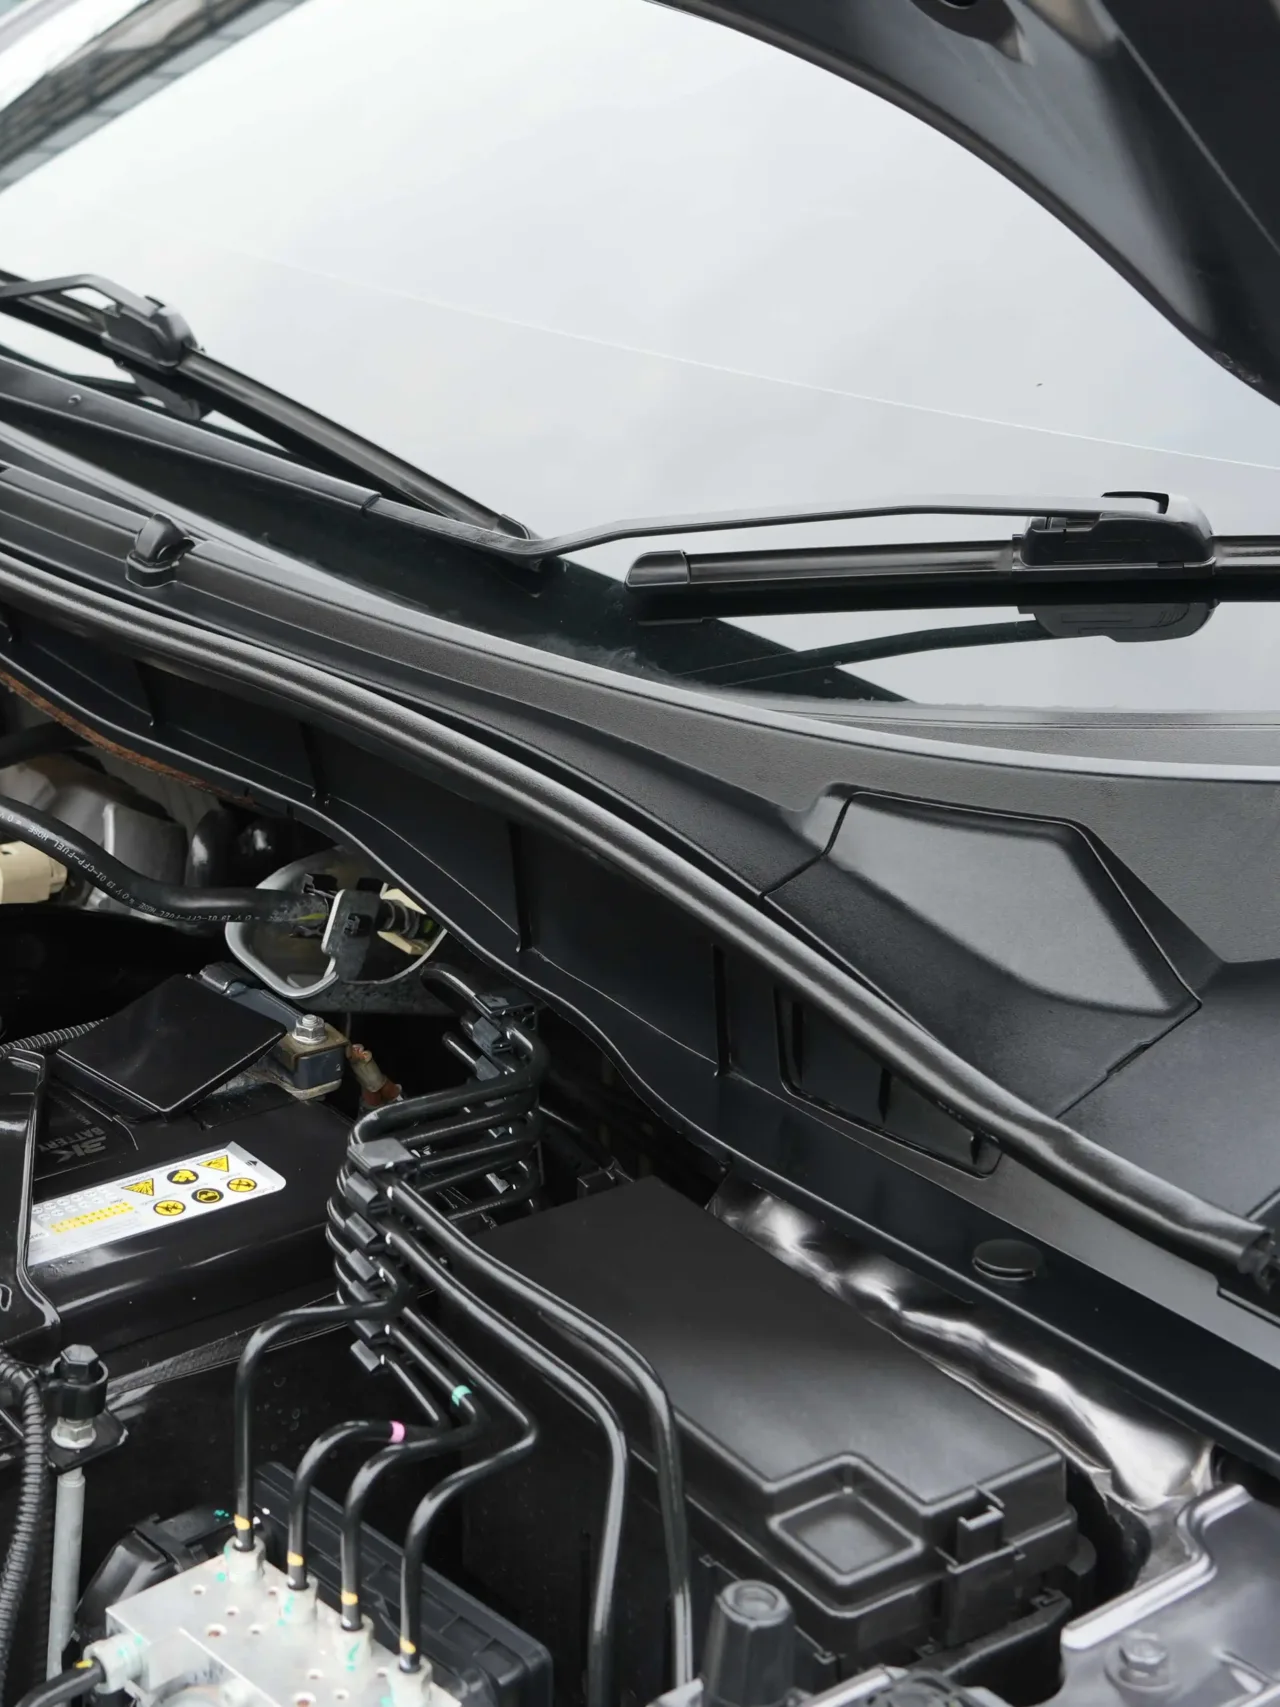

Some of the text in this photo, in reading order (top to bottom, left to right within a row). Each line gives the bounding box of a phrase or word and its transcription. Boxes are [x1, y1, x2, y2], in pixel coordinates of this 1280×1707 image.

[27, 824, 49, 841] HOSE
[53, 839, 107, 882] 01-CFP-FUEL
[38, 1126, 106, 1152] BATTERY
[48, 1135, 107, 1164] 3K
